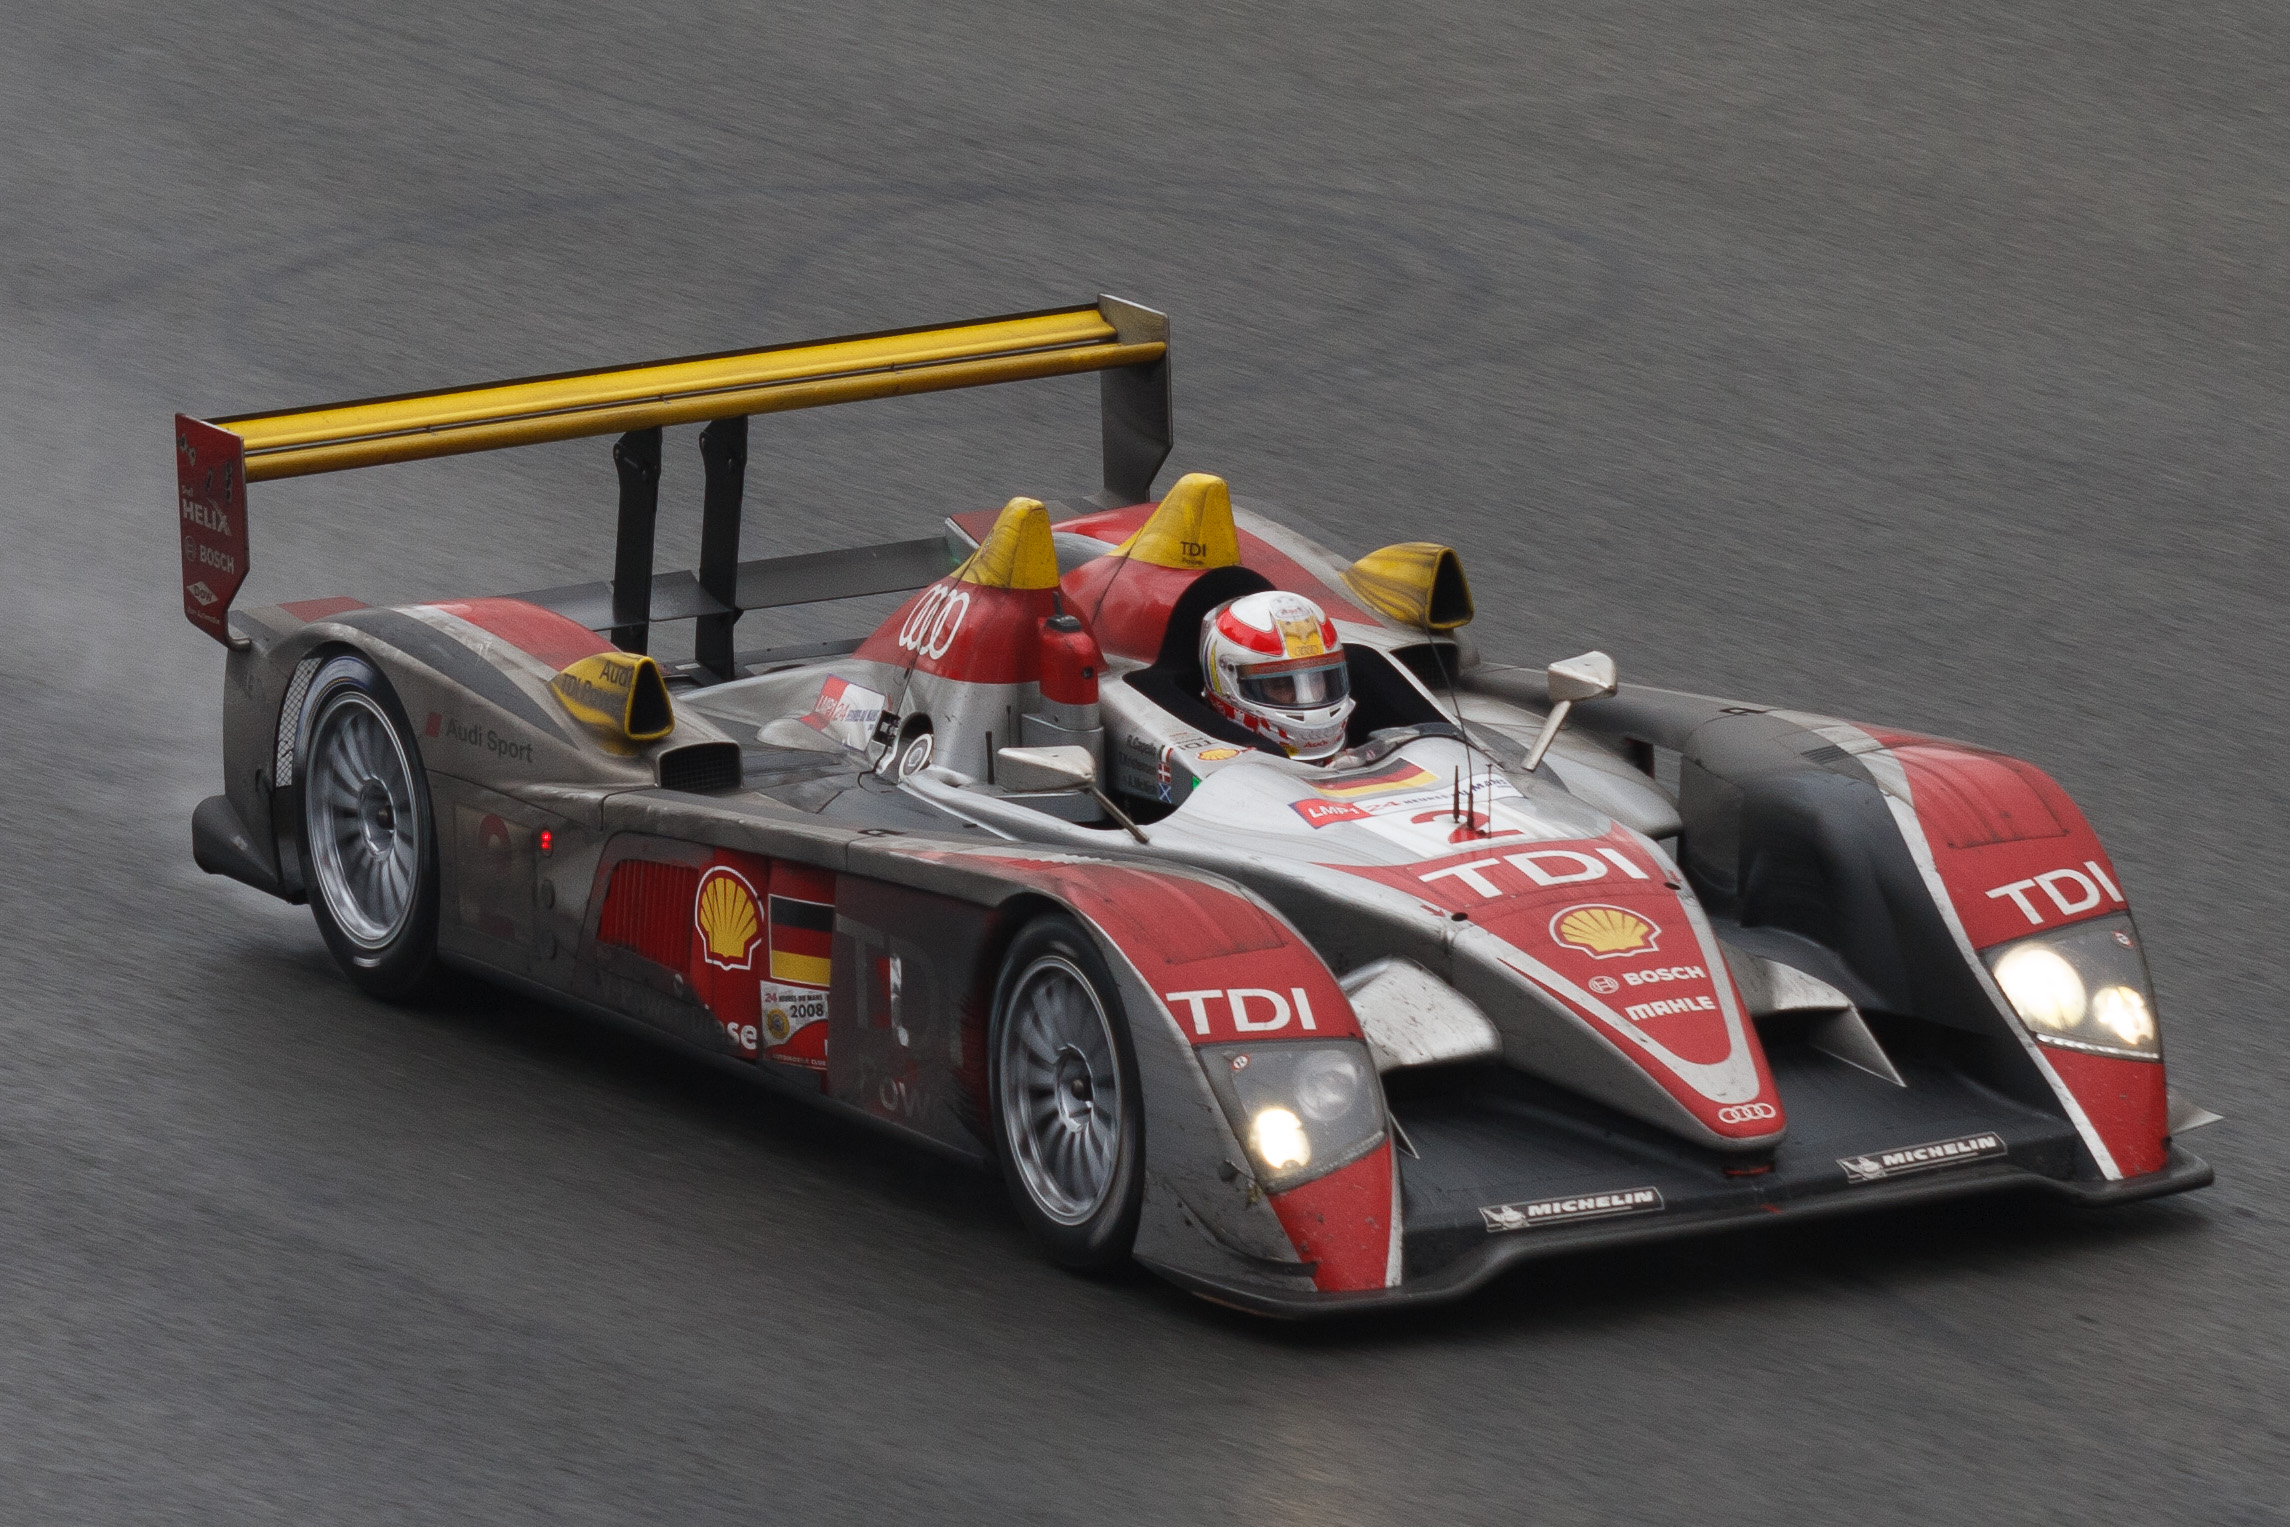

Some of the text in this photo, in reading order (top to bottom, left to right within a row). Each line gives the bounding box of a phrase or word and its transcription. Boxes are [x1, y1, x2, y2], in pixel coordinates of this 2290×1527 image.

[182, 498, 232, 536] HELIX
[200, 544, 234, 575] BOSCH
[1181, 541, 1206, 557] TDI
[599, 660, 635, 690] Audi
[446, 719, 534, 763] Audi Sport
[1308, 805, 1359, 819] LMP1
[1365, 802, 1400, 813] 24
[1410, 809, 1524, 844] 2
[1417, 848, 1651, 898] TDI
[1985, 860, 2125, 926] TDI
[1621, 965, 1707, 986] BOSCH
[765, 993, 778, 1003] 24
[790, 1003, 824, 1018] 2008
[1165, 987, 1318, 1035] TDI
[1625, 995, 1717, 1021] MAHLE
[1882, 1136, 1998, 1167] MICHELIN
[1528, 1191, 1654, 1217] MICHELIN
